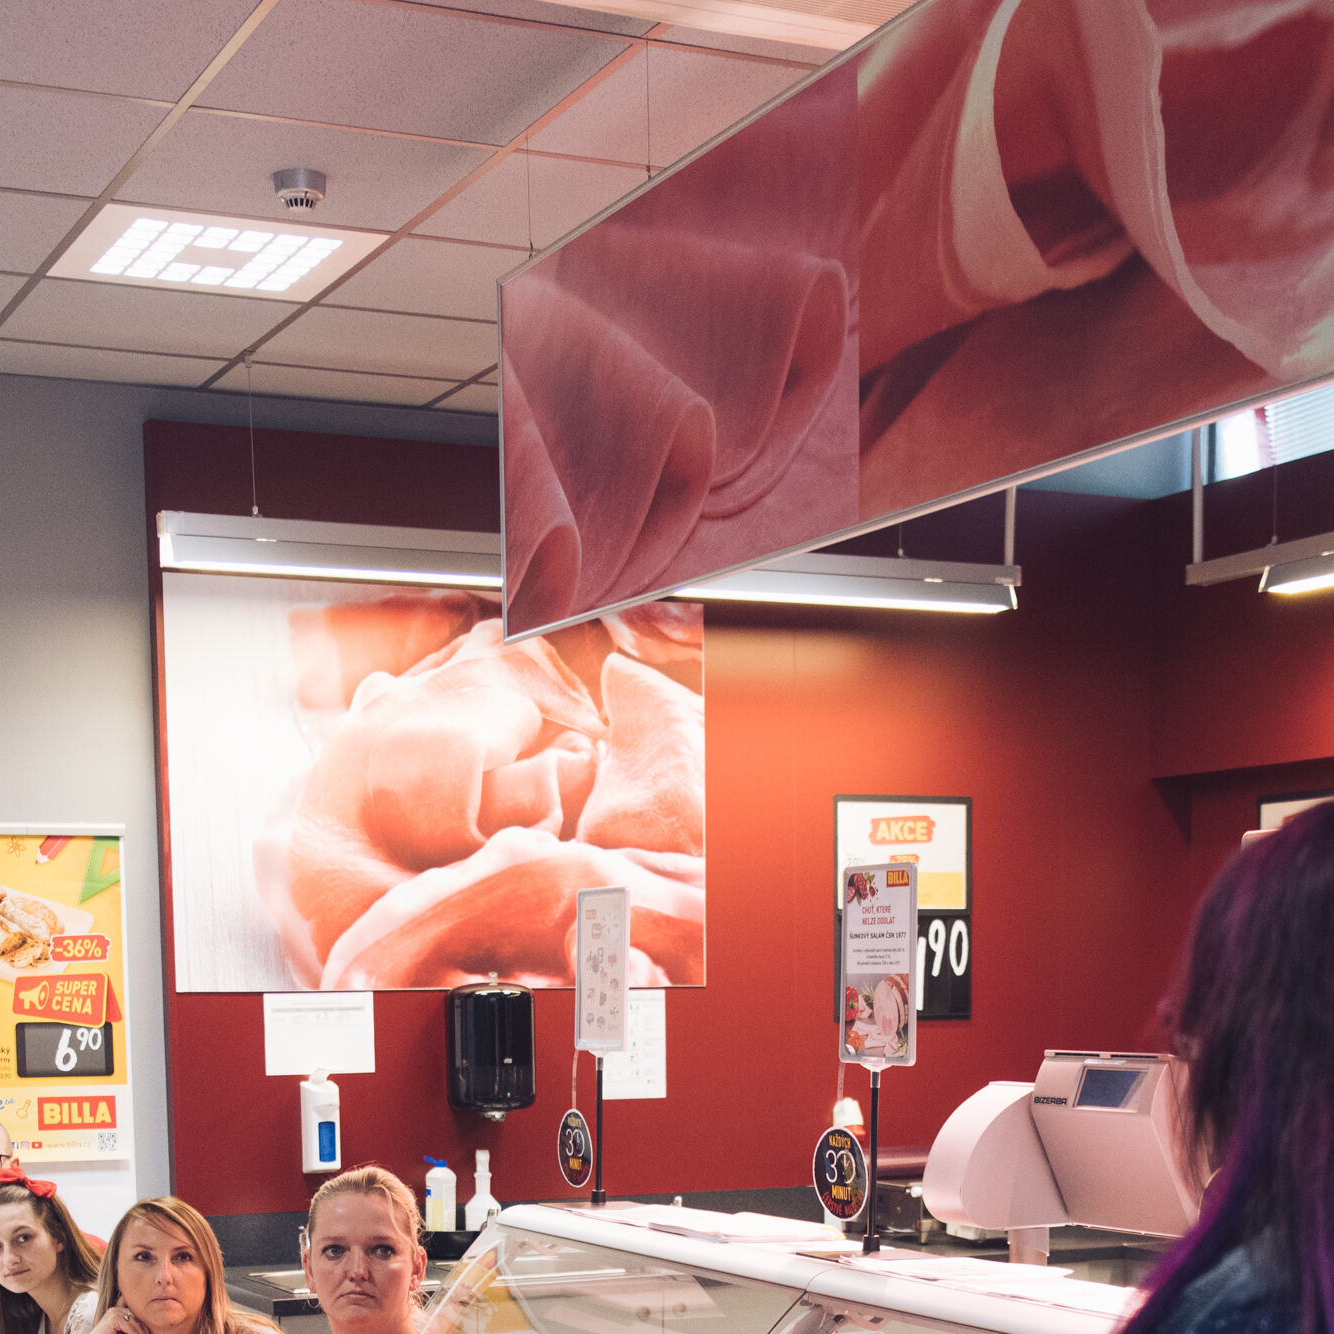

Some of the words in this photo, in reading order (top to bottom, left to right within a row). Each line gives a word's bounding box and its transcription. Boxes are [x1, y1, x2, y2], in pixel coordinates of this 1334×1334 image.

[876, 821, 929, 841] AKCE
[888, 870, 909, 885] BILLA
[862, 917, 877, 925] NELZE
[896, 931, 907, 939] 1977
[54, 939, 103, 958] -36%
[55, 980, 98, 996] SUPER
[51, 996, 93, 1015] CENA
[1034, 1096, 1068, 1106] BIZERBA
[42, 1101, 113, 1126] BILLA
[828, 1133, 851, 1149] KAŽDÝCH
[831, 1184, 852, 1201] MINUT
